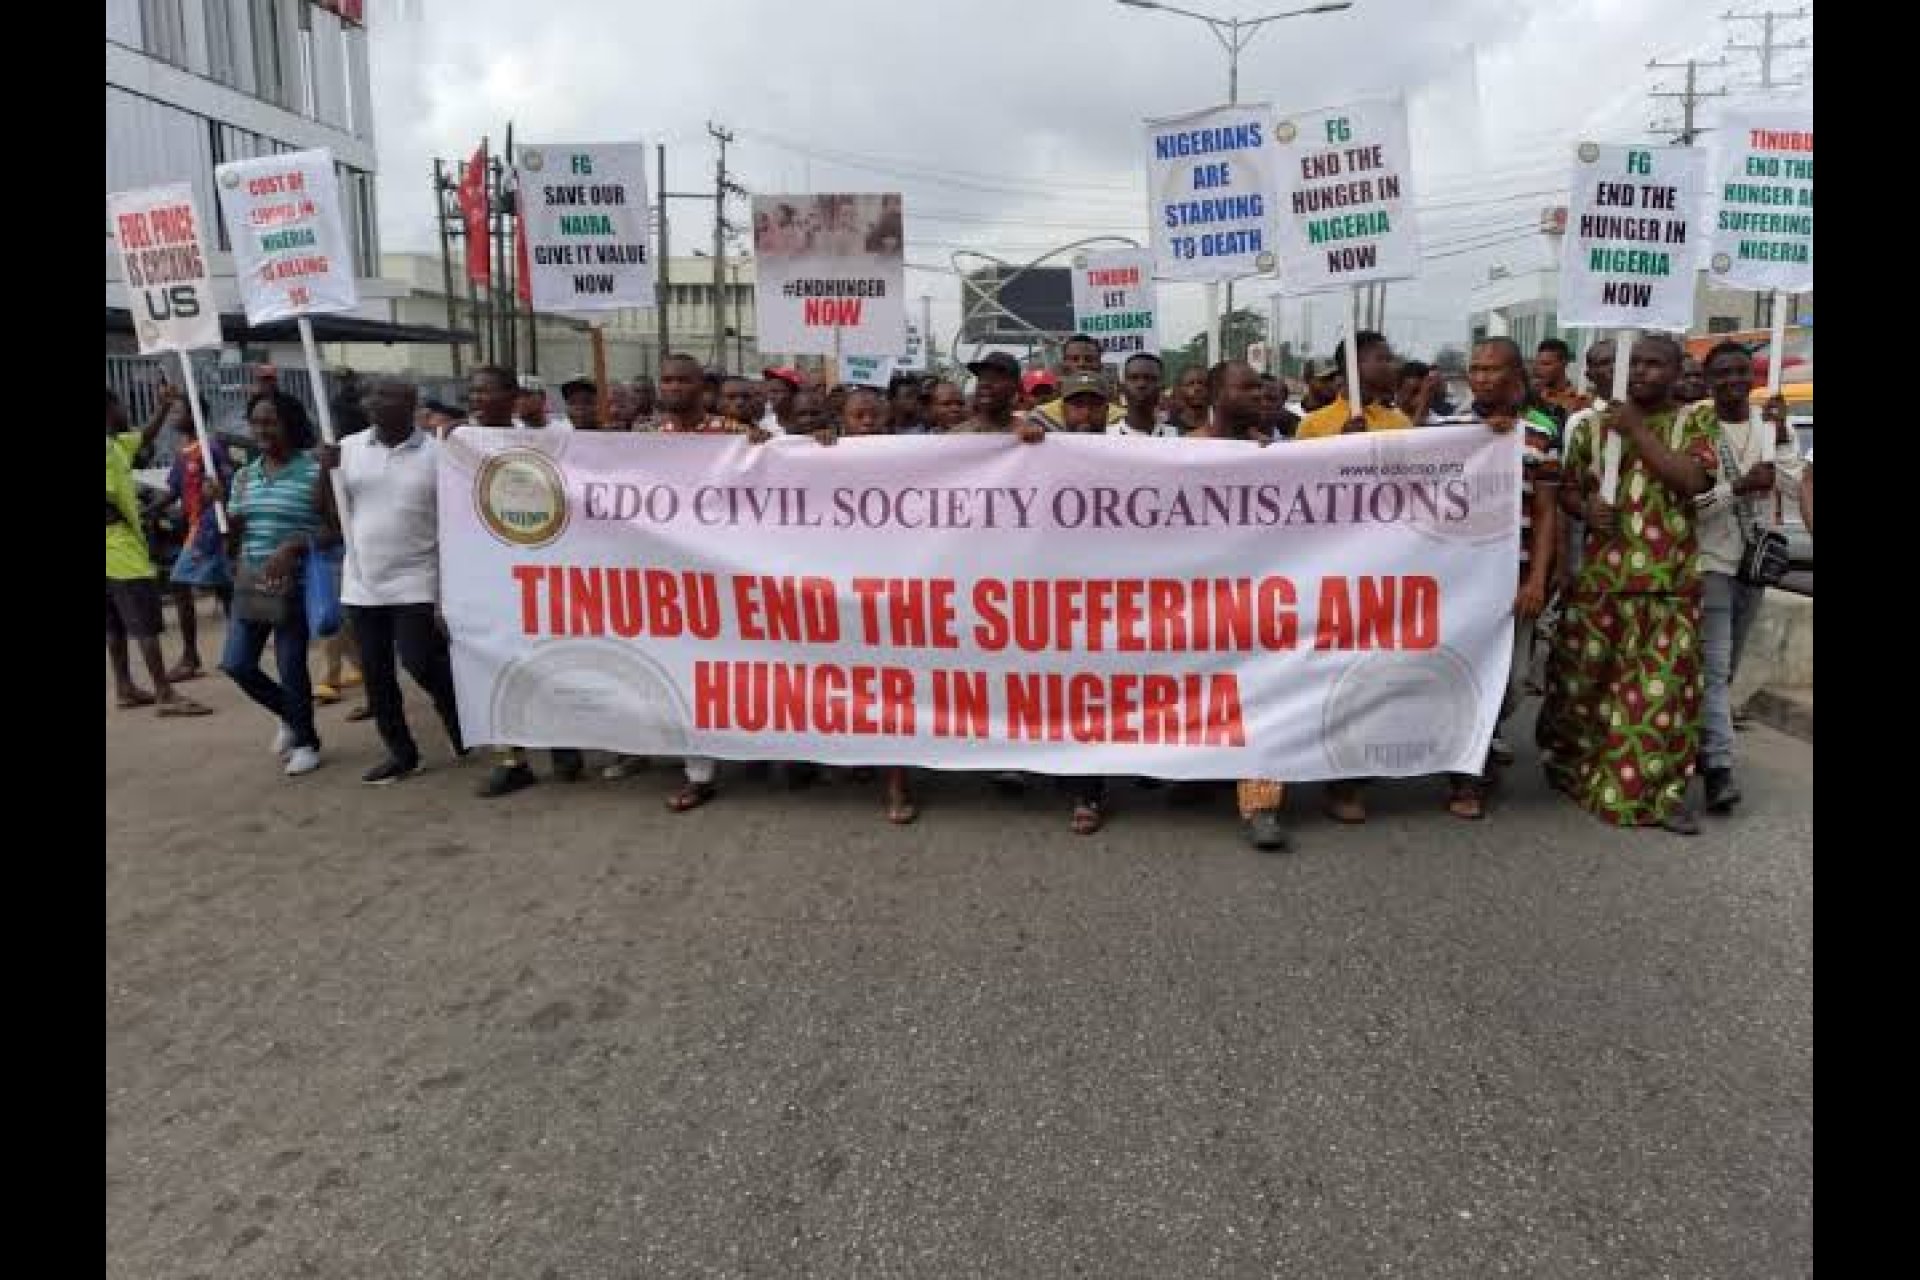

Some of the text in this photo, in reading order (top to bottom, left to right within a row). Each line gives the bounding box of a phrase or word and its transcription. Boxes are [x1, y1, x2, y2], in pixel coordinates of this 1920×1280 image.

[1155, 122, 1263, 161] NIGERIANS
[1325, 116, 1350, 144] FG
[1751, 129, 1813, 152] TINUBU
[572, 154, 592, 174] FG
[1300, 144, 1385, 180] END THE
[1628, 151, 1651, 174] FG
[1746, 156, 1813, 179] END THE
[248, 176, 285, 197] COST
[1194, 162, 1232, 190] ARE
[544, 186, 626, 206] SAVE OUR
[1292, 175, 1400, 214] HUNGER IN
[1597, 182, 1678, 211] END THE
[1725, 183, 1793, 206] HUNGER
[1164, 193, 1264, 227] STARVING
[1718, 210, 1811, 236] SUFFERING
[118, 204, 195, 250] FUEL PRICE
[261, 228, 315, 251] NIGERIA
[1308, 210, 1391, 244] NIGERIA
[1581, 214, 1686, 244] HUNGER IN
[535, 245, 647, 264] GIVE IT VALUE
[1170, 228, 1263, 259] TO DEATH
[1738, 240, 1809, 263] NIGERIA
[276, 255, 329, 278] KILLING
[1327, 245, 1377, 272] NOW
[1590, 247, 1670, 276] NIGERIA
[574, 274, 614, 294] NOW
[782, 279, 886, 298] #ENDHUNGER
[1602, 281, 1652, 307] NOW
[145, 286, 201, 321] US
[804, 299, 862, 327] NOW
[1103, 291, 1126, 310] LET
[1078, 311, 1153, 332] NIGERIANS
[582, 481, 679, 524] EDO
[694, 486, 823, 528] CIVIL
[831, 486, 1038, 529] SOCIETY
[1052, 477, 1471, 530] ORGANISATIONS
[512, 564, 1441, 653] TINUBU END THE SUFFERING AND
[694, 659, 1246, 748] HUNGER IN NIGERIA
